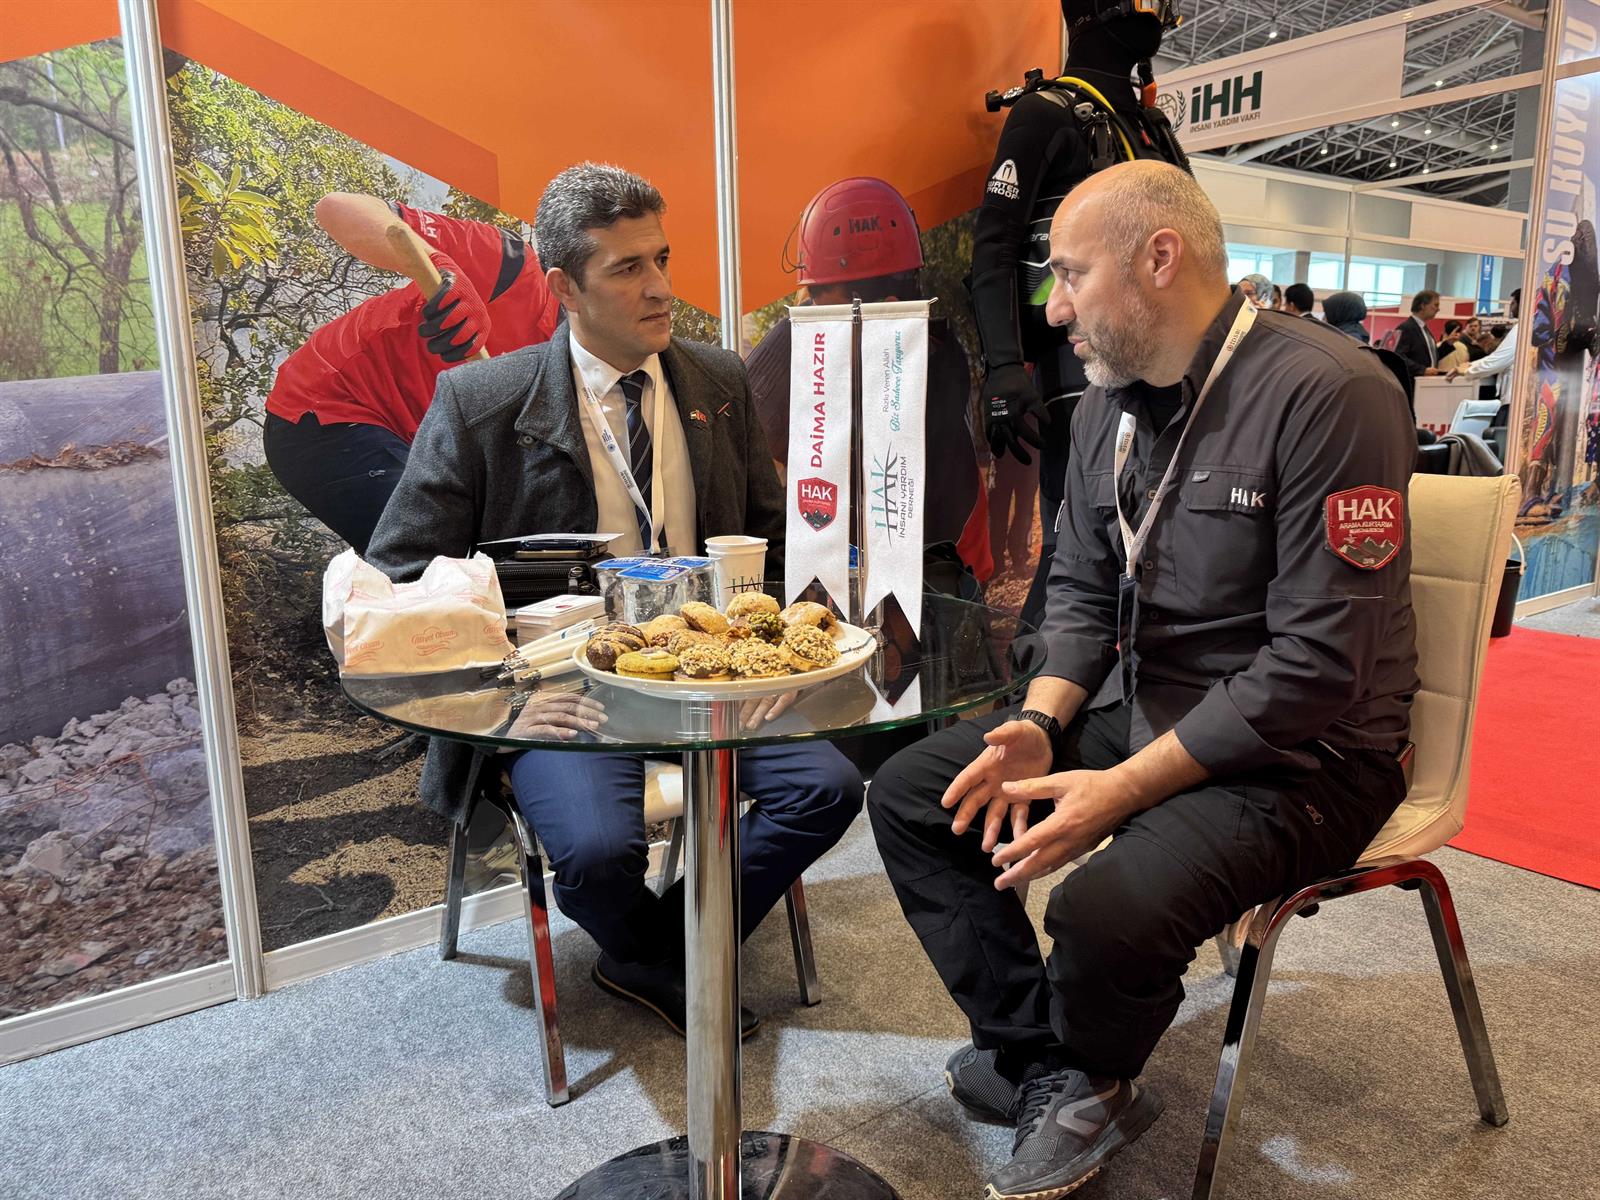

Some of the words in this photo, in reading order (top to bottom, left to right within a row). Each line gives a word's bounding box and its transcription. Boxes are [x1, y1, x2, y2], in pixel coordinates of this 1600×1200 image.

[1213, 117, 1239, 128] YARDIM
[988, 181, 1019, 194] WATER
[1543, 208, 1578, 266] SU
[814, 332, 825, 395] HAZIR
[890, 413, 900, 432] Biz
[810, 402, 825, 468] DAİMA
[801, 484, 832, 501] HAK
[871, 451, 898, 531] HAK
[1231, 487, 1266, 507] HAK
[1337, 497, 1396, 521] HAK
